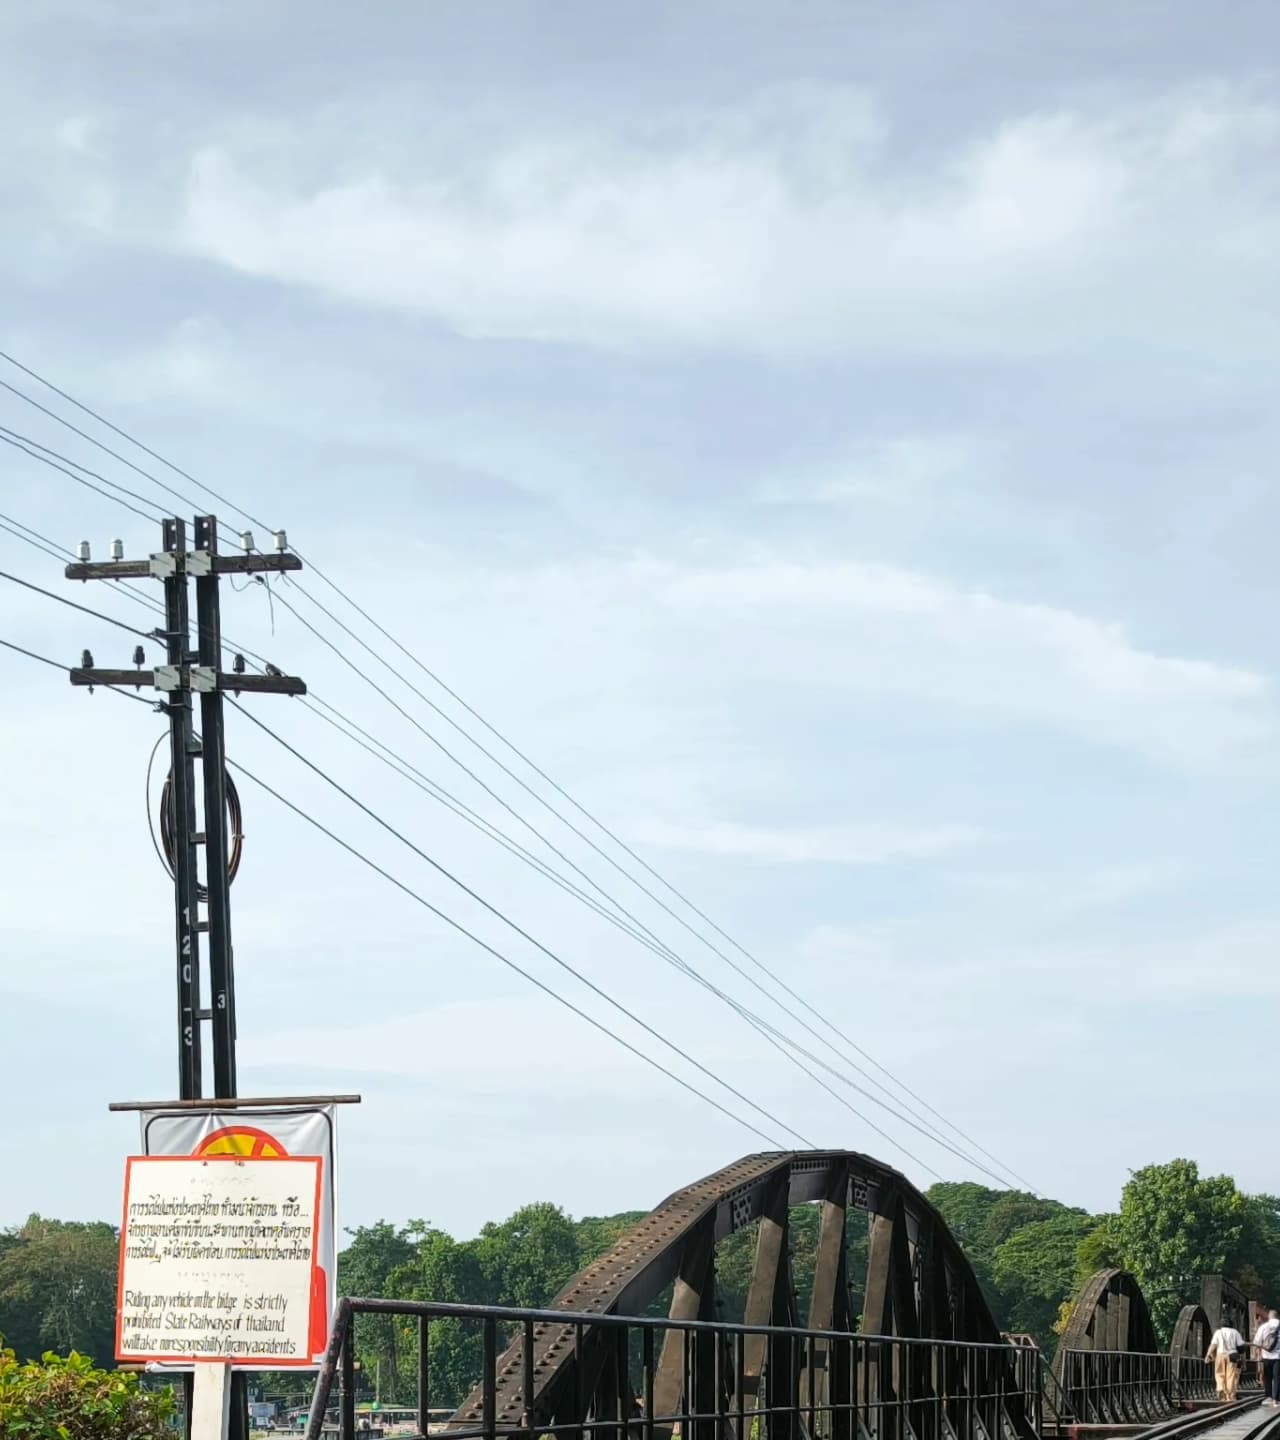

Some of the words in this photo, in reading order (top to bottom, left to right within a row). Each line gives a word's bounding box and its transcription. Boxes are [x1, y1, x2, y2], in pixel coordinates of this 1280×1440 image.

[125, 1290, 151, 1312] Riding
[151, 1295, 169, 1312] any
[244, 1293, 253, 1310] is
[254, 1293, 288, 1314] strictly
[165, 1312, 188, 1330] State
[189, 1312, 233, 1334] Railways
[246, 1315, 285, 1332] thailand
[251, 1338, 296, 1354] accidents
